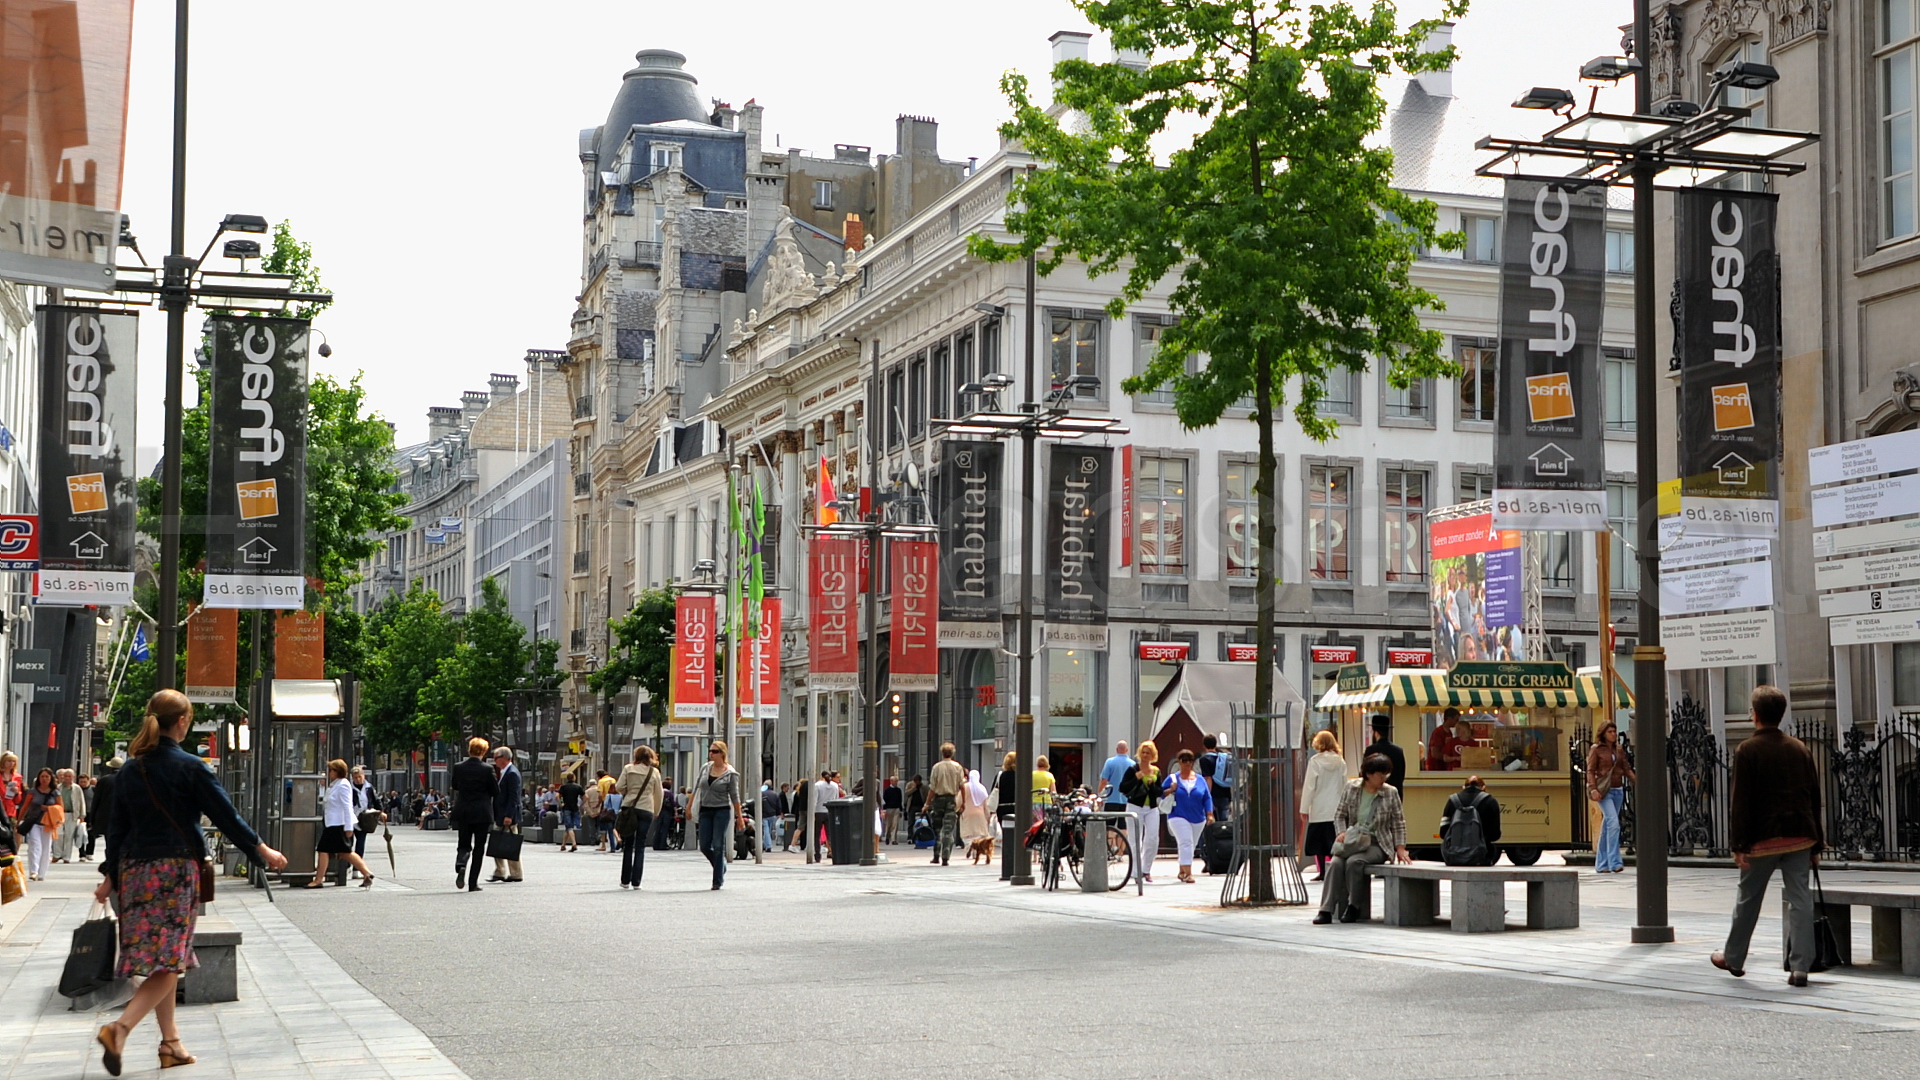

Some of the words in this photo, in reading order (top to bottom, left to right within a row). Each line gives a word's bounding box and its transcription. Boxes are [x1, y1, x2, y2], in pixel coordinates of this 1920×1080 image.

[953, 471, 987, 599] habitat
[1434, 536, 1447, 546] Geen
[1448, 533, 1464, 543] zomer
[1465, 529, 1484, 541] zonder
[820, 554, 847, 654] ESPRIT
[939, 628, 1000, 639] meir-as.be
[685, 608, 706, 689] ESPRIT
[1147, 647, 1181, 658] ESPRIT
[1319, 650, 1351, 661] ESPRIT
[1395, 652, 1426, 664] ESPRIT
[1340, 677, 1356, 690] SOFT
[1356, 676, 1368, 688] ICE
[1453, 674, 1490, 687] SOFT
[1493, 674, 1519, 687] ICE
[1521, 674, 1569, 688] CREAM
[187, 689, 234, 698] meir-as.be
[1515, 803, 1546, 815] Cream
